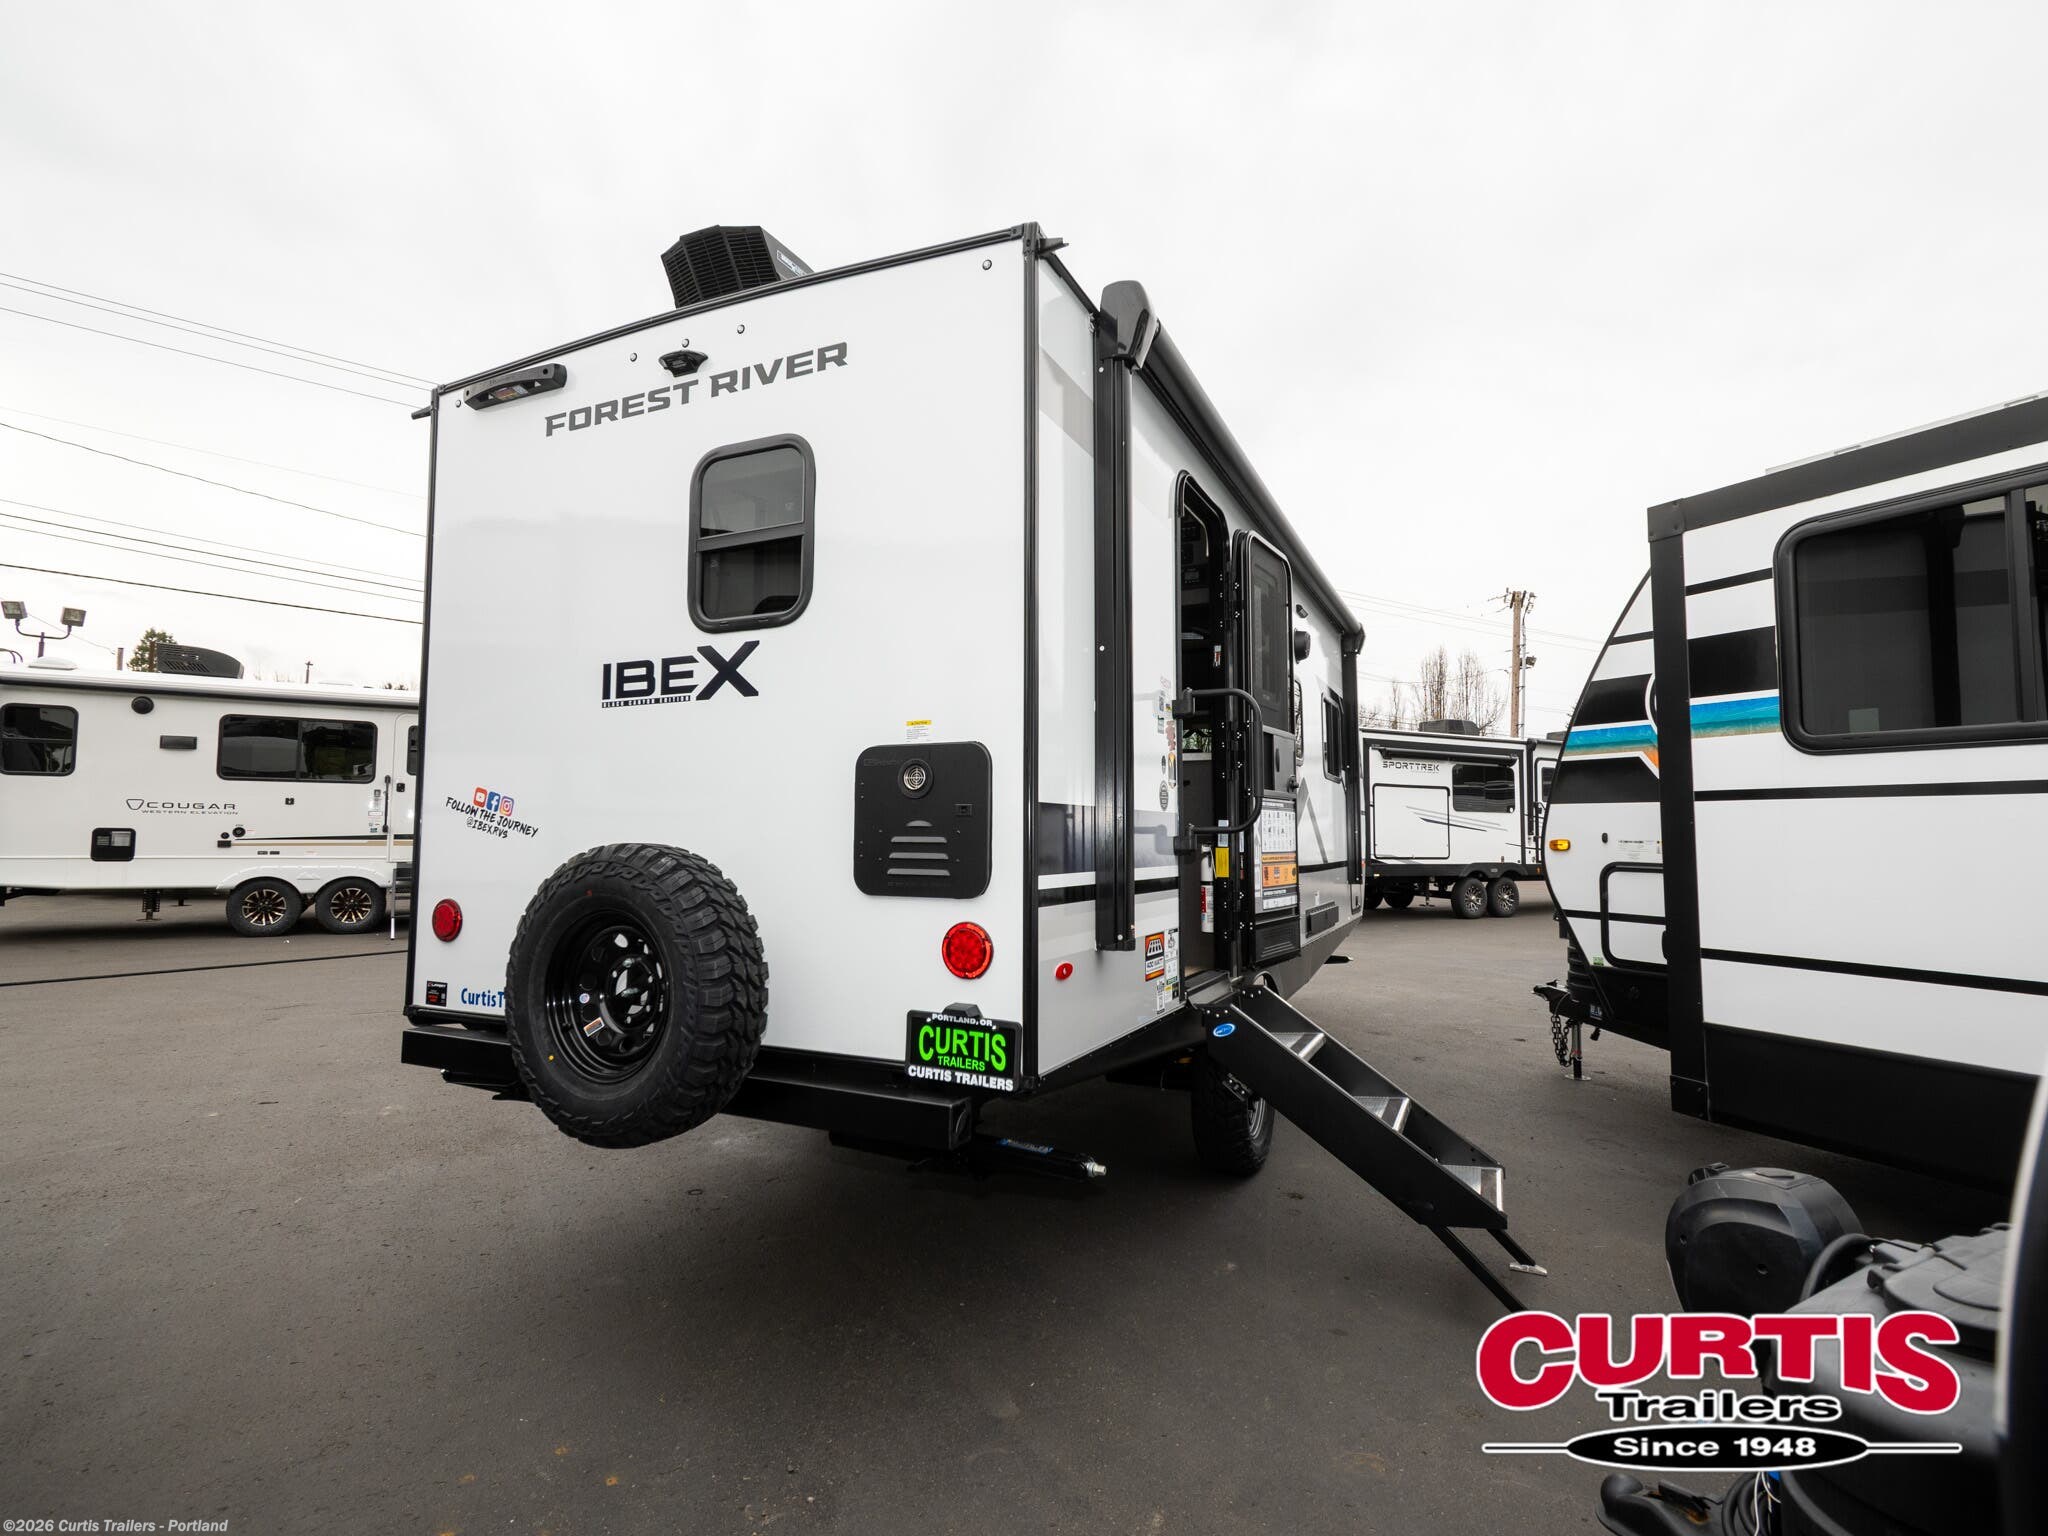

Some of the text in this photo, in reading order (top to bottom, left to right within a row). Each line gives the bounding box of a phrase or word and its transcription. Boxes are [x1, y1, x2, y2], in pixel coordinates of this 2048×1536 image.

[544, 342, 848, 437] FOREST RIVER
[602, 640, 760, 700] IBEX
[1382, 761, 1440, 771] SPORTTREK
[147, 802, 236, 810] COUGAR
[446, 797, 539, 837] FOLLOW THE JOURNEY
[932, 1013, 993, 1027] PORTLAND, OR
[919, 1025, 1006, 1071] CURTIS
[938, 1055, 986, 1072] TRAILERS
[908, 1065, 1014, 1091] CURTIS TRAILERS
